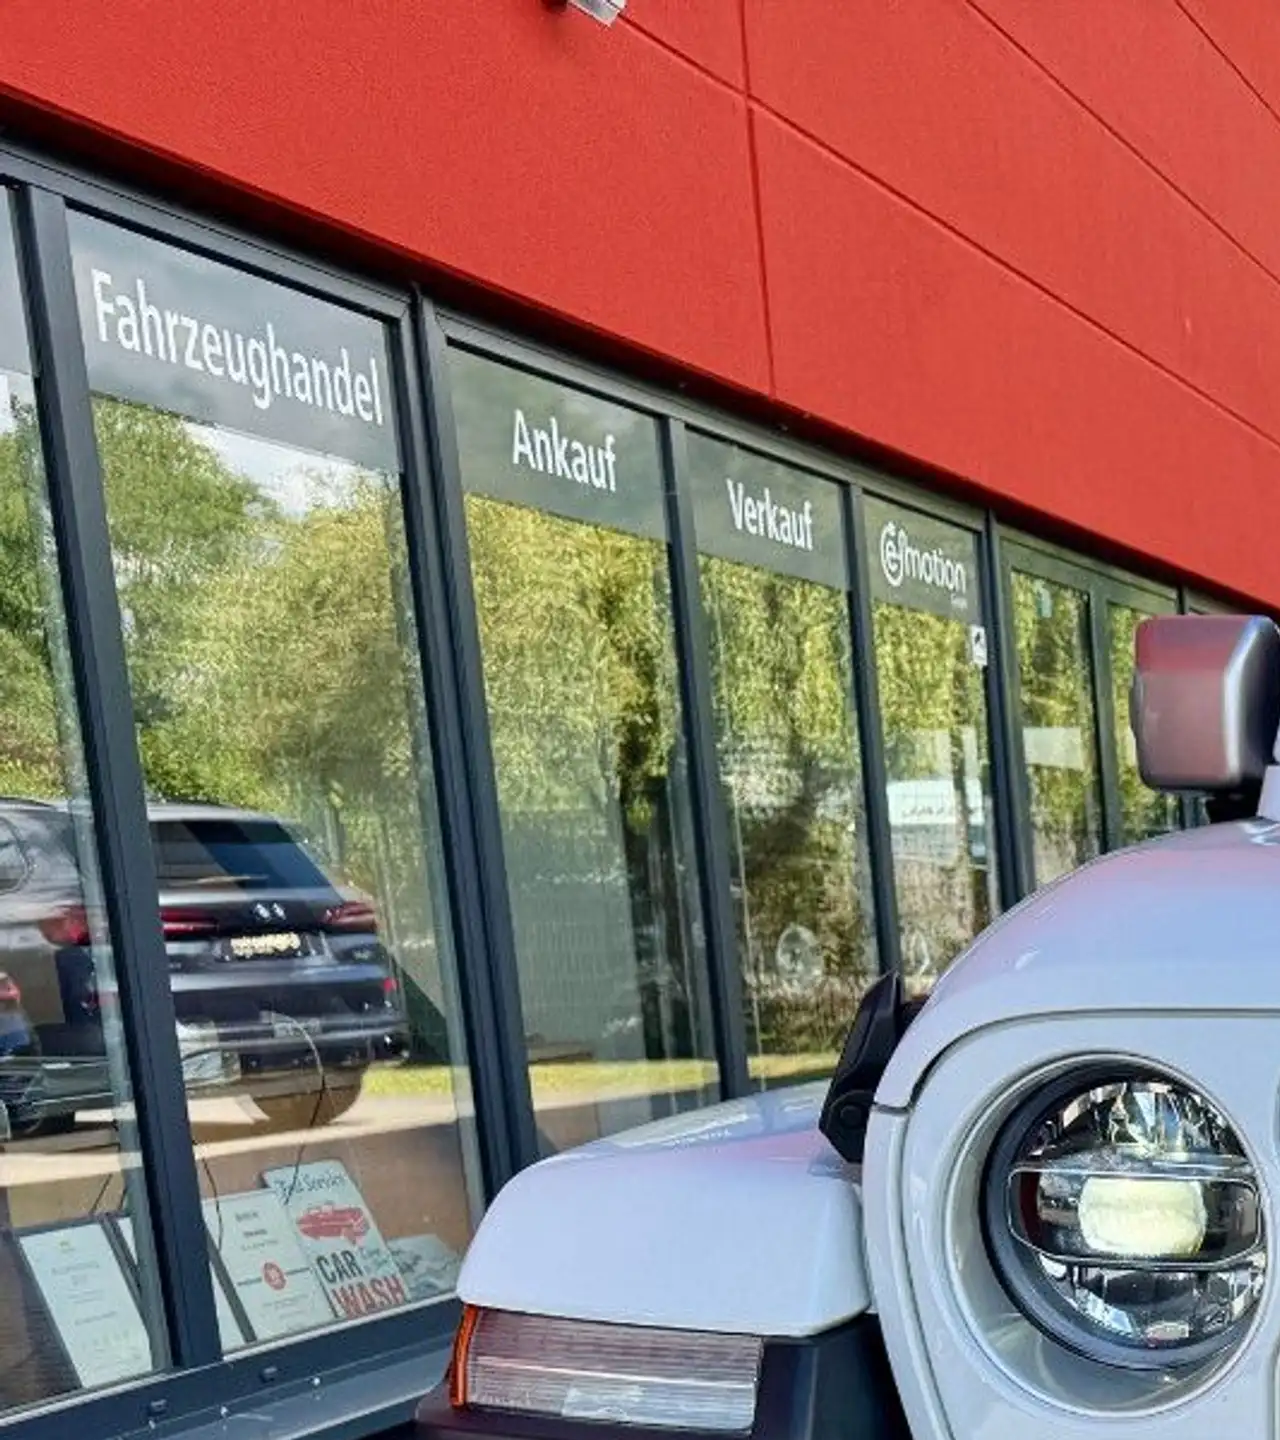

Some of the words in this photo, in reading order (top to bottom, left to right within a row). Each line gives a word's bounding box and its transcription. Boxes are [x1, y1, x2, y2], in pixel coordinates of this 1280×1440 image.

[91, 267, 385, 425] Fahrzeughandel
[512, 409, 617, 492] Ankauf
[726, 479, 813, 551] Verkauf
[316, 1250, 364, 1283] CAR
[331, 1274, 406, 1320] WASH
